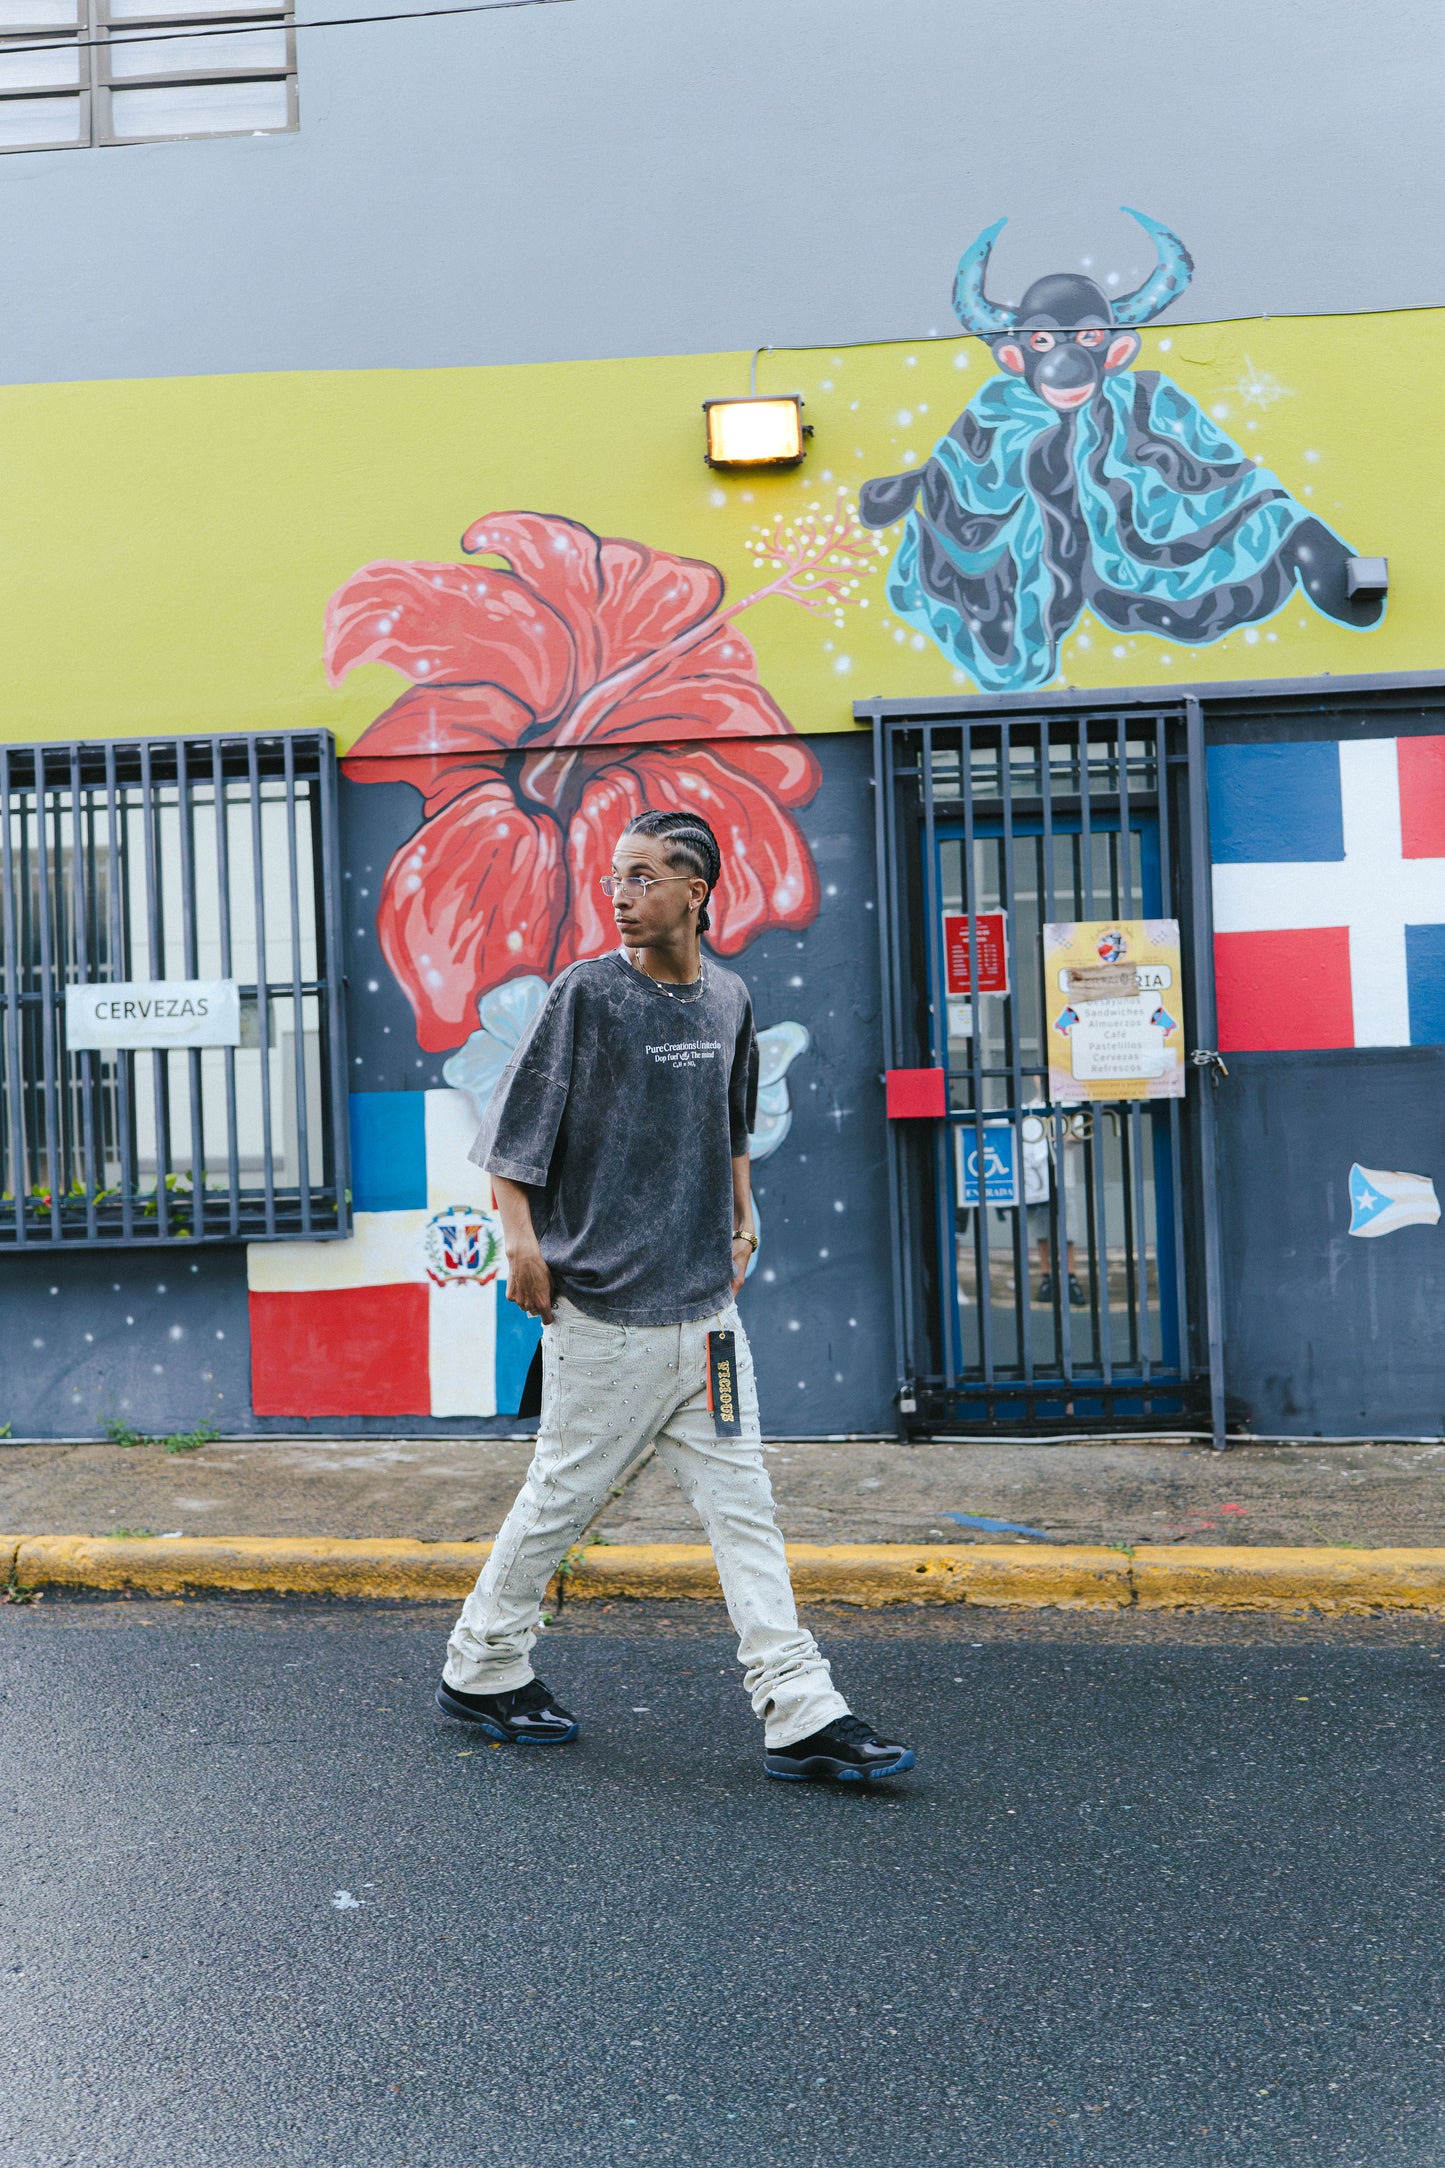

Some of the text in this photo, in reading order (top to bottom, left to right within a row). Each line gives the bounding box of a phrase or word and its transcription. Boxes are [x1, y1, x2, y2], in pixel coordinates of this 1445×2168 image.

[95, 998, 208, 1020] CERVEZAS
[1085, 1007, 1145, 1018] Sandwiches
[1088, 1019, 1142, 1028] Almuerzos
[1103, 1029, 1127, 1039] Café
[1089, 1040, 1142, 1050] Pastelillos
[1093, 1050, 1140, 1061] Cervezas
[1091, 1062, 1142, 1073] Refrescos
[966, 1187, 1014, 1198] ENRADA
[717, 1360, 734, 1421] VICIOUS
